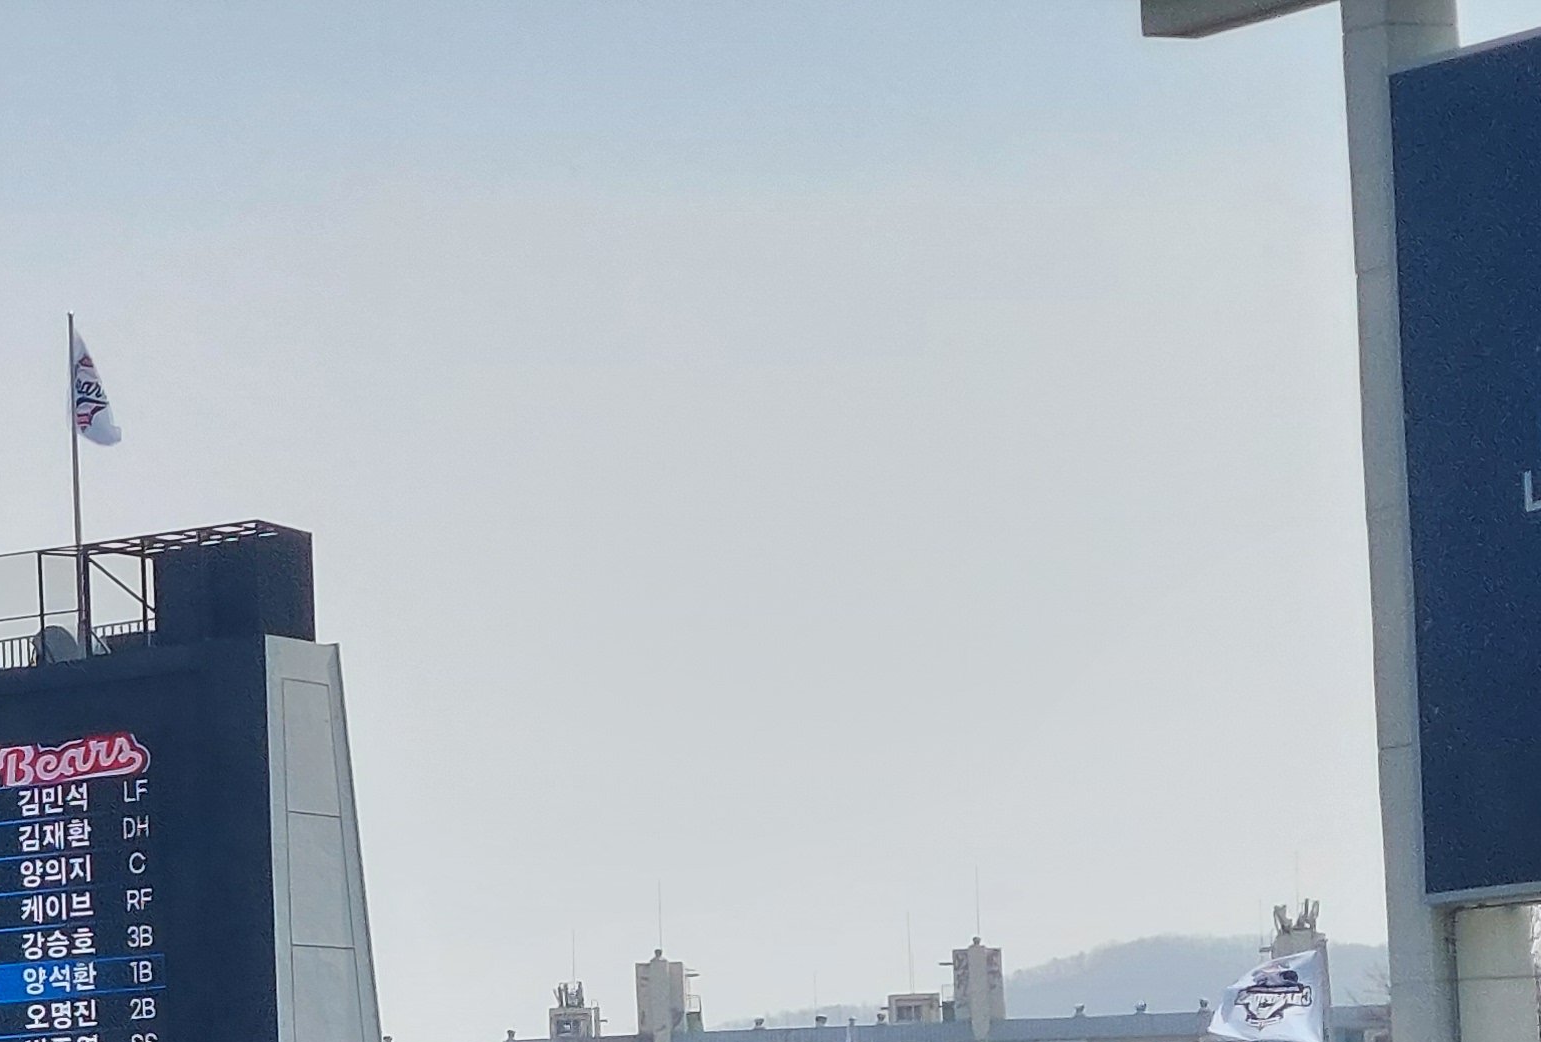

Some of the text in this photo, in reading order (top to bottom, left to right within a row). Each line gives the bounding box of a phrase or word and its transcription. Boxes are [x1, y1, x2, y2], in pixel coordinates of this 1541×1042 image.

[18, 779, 148, 817] 김민석 LF
[19, 815, 149, 852] 김재환 DH
[20, 852, 145, 887] 양의지 C
[21, 888, 152, 923] 케이브 RF
[22, 925, 152, 959] 강승호 3B
[24, 960, 152, 999] 양석환 1B
[25, 998, 155, 1029] 오명진 2B
